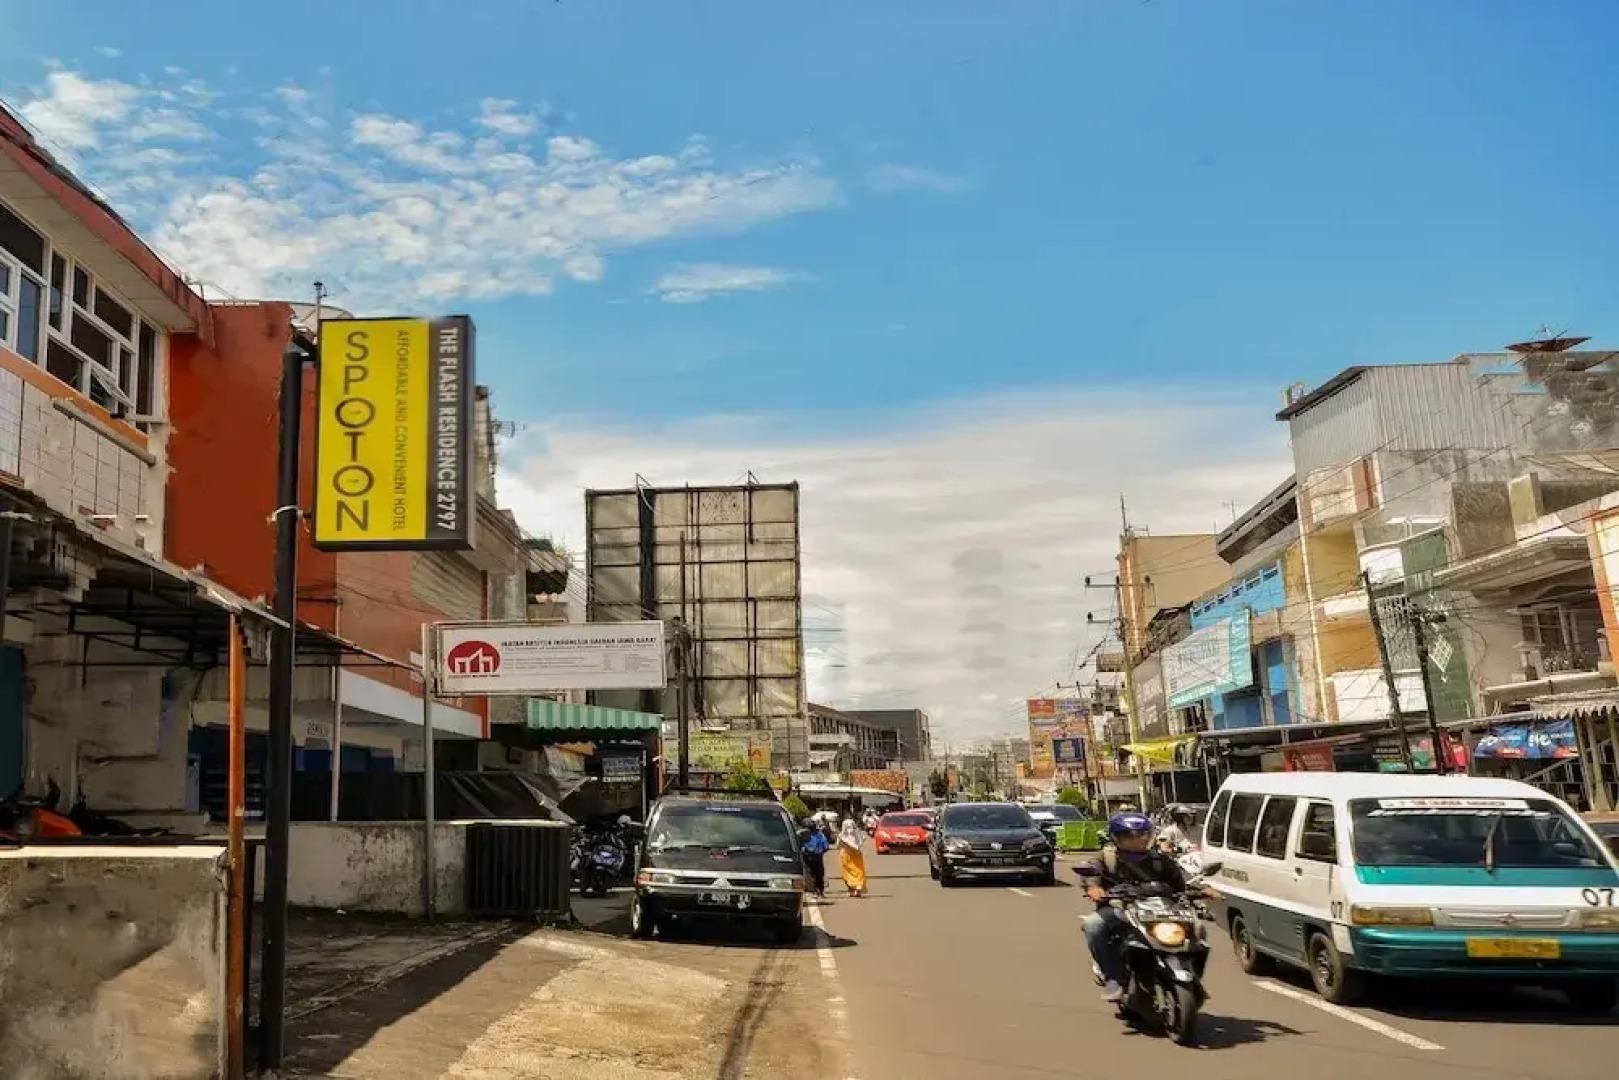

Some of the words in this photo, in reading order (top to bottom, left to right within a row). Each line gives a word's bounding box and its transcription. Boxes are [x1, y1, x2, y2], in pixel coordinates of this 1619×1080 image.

[439, 327, 459, 354] THE
[395, 330, 409, 395] AFFORDABLE
[438, 358, 459, 402] FLASH
[395, 398, 408, 422] AND
[393, 426, 408, 496] CONVENIENT
[437, 407, 457, 489] RESIDENCE
[393, 498, 406, 530] HOTEL
[436, 493, 456, 530] 2797
[1331, 900, 1343, 919] 07
[1582, 888, 1614, 906] 07
